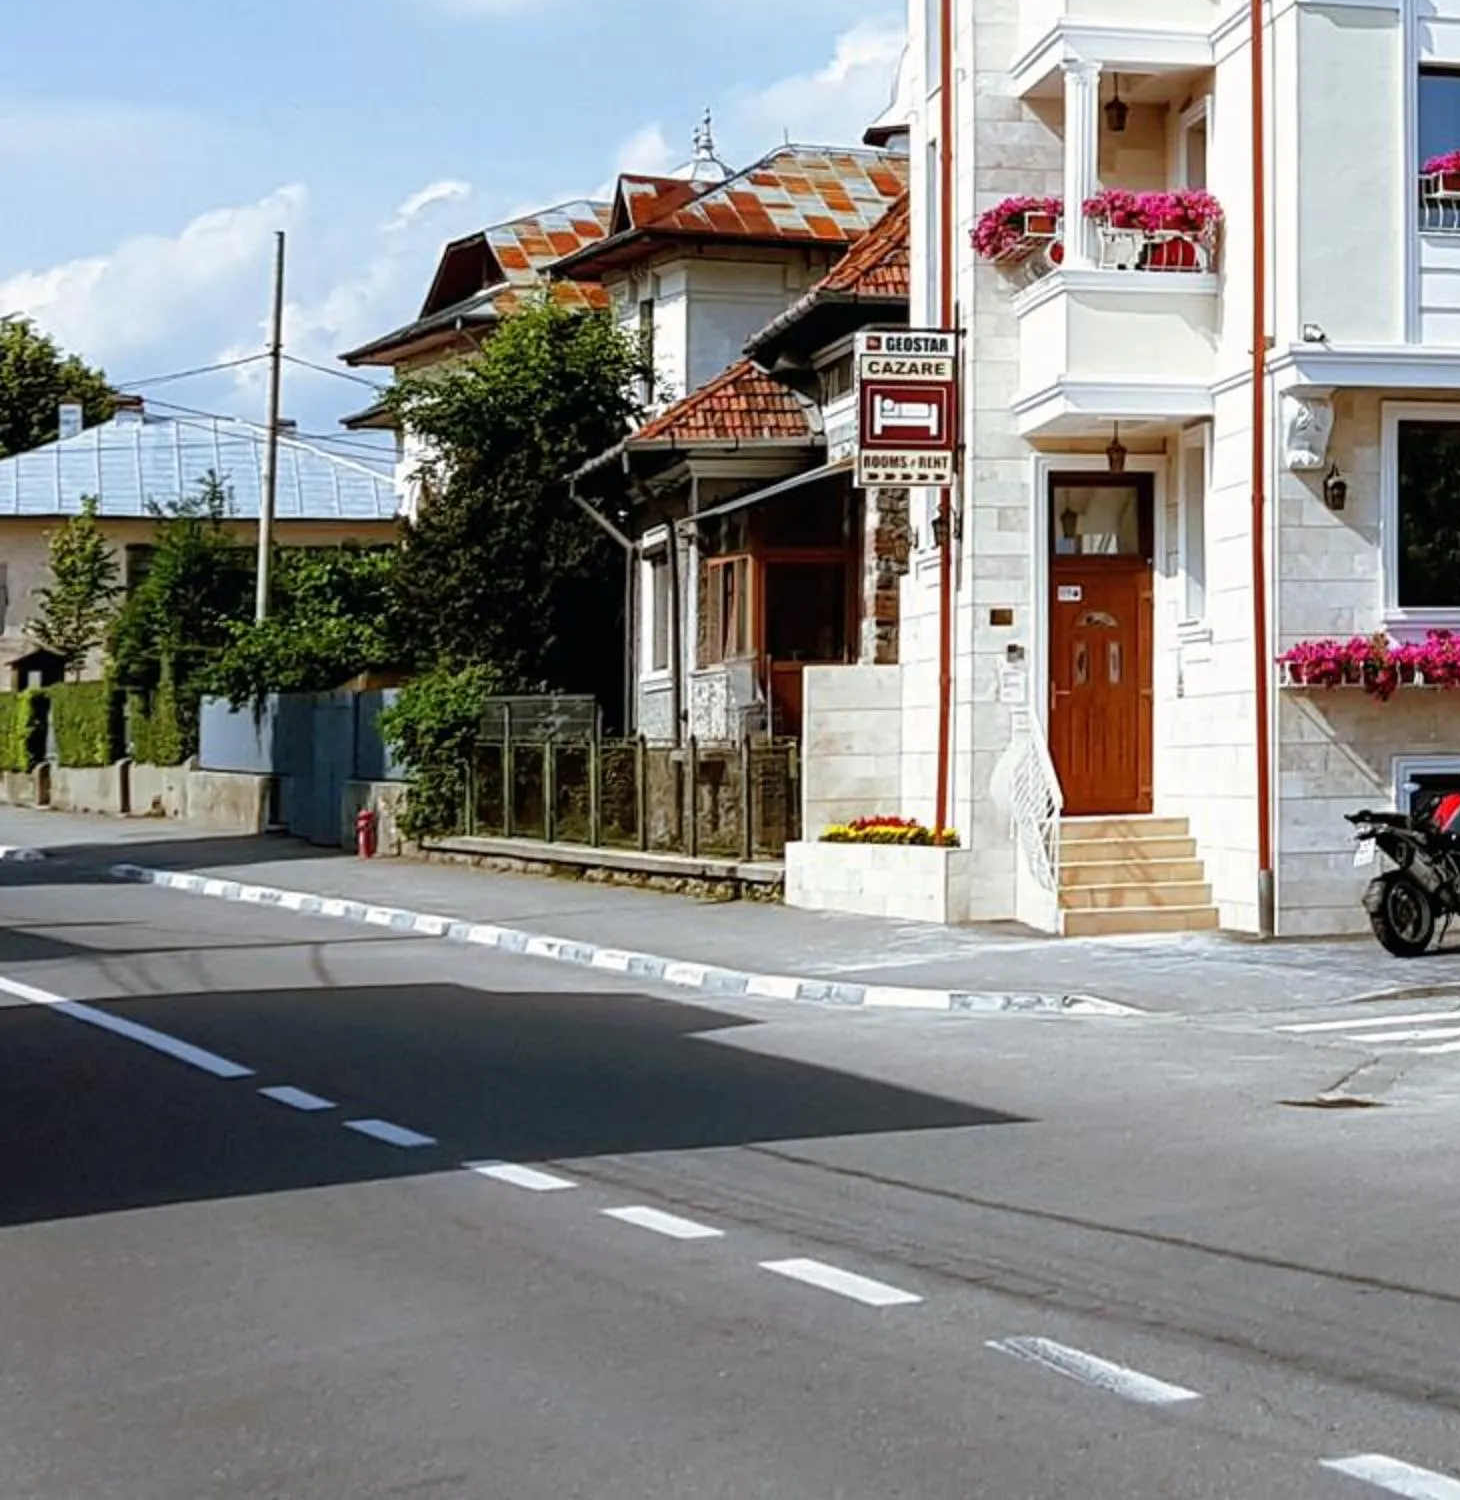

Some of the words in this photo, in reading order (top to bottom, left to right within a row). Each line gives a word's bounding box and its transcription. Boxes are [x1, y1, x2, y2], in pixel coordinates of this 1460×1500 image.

[886, 337, 949, 352] GEOSTAR
[868, 361, 945, 375] CAZARE
[864, 456, 908, 469] ROOMS
[918, 456, 948, 469] RENT
